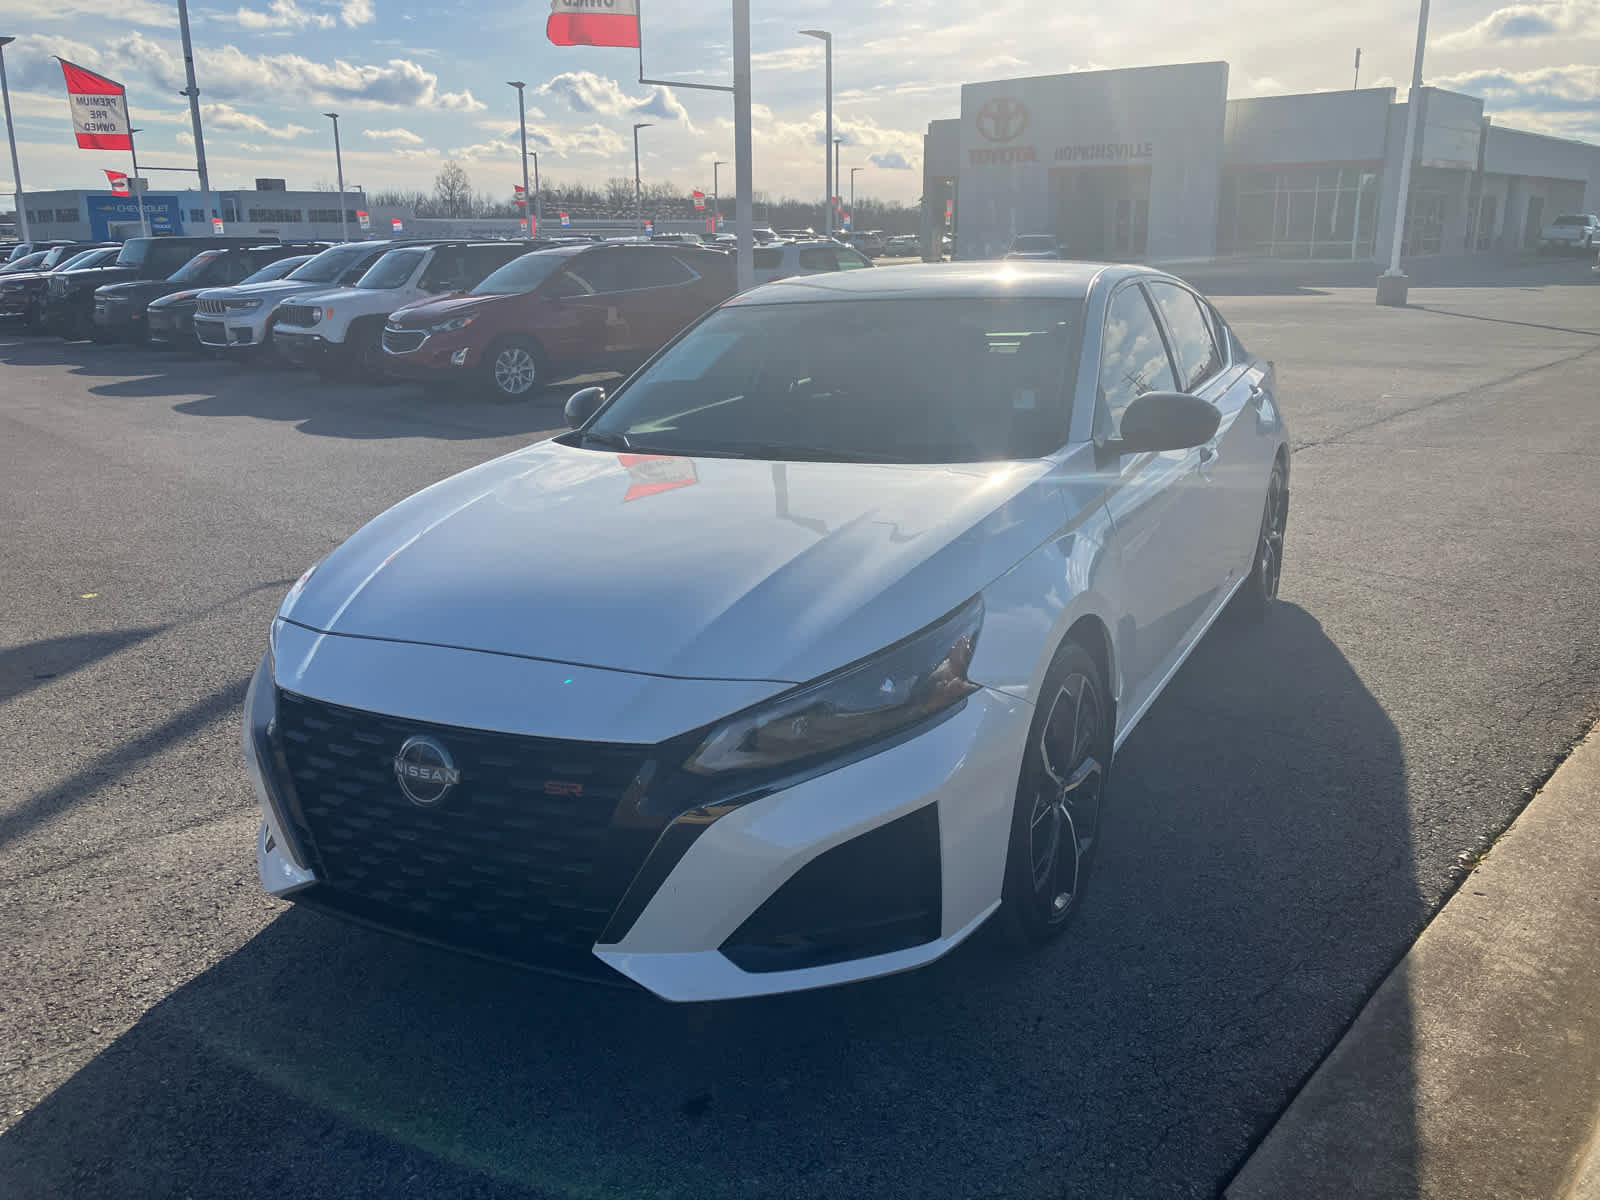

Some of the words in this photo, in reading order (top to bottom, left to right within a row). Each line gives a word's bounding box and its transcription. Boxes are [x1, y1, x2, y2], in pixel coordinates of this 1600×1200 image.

[1054, 142, 1153, 161] HOPKINSVILLE
[116, 204, 169, 213] CHEVROLET
[394, 758, 460, 783] NISSAN
[544, 781, 584, 797] SR
